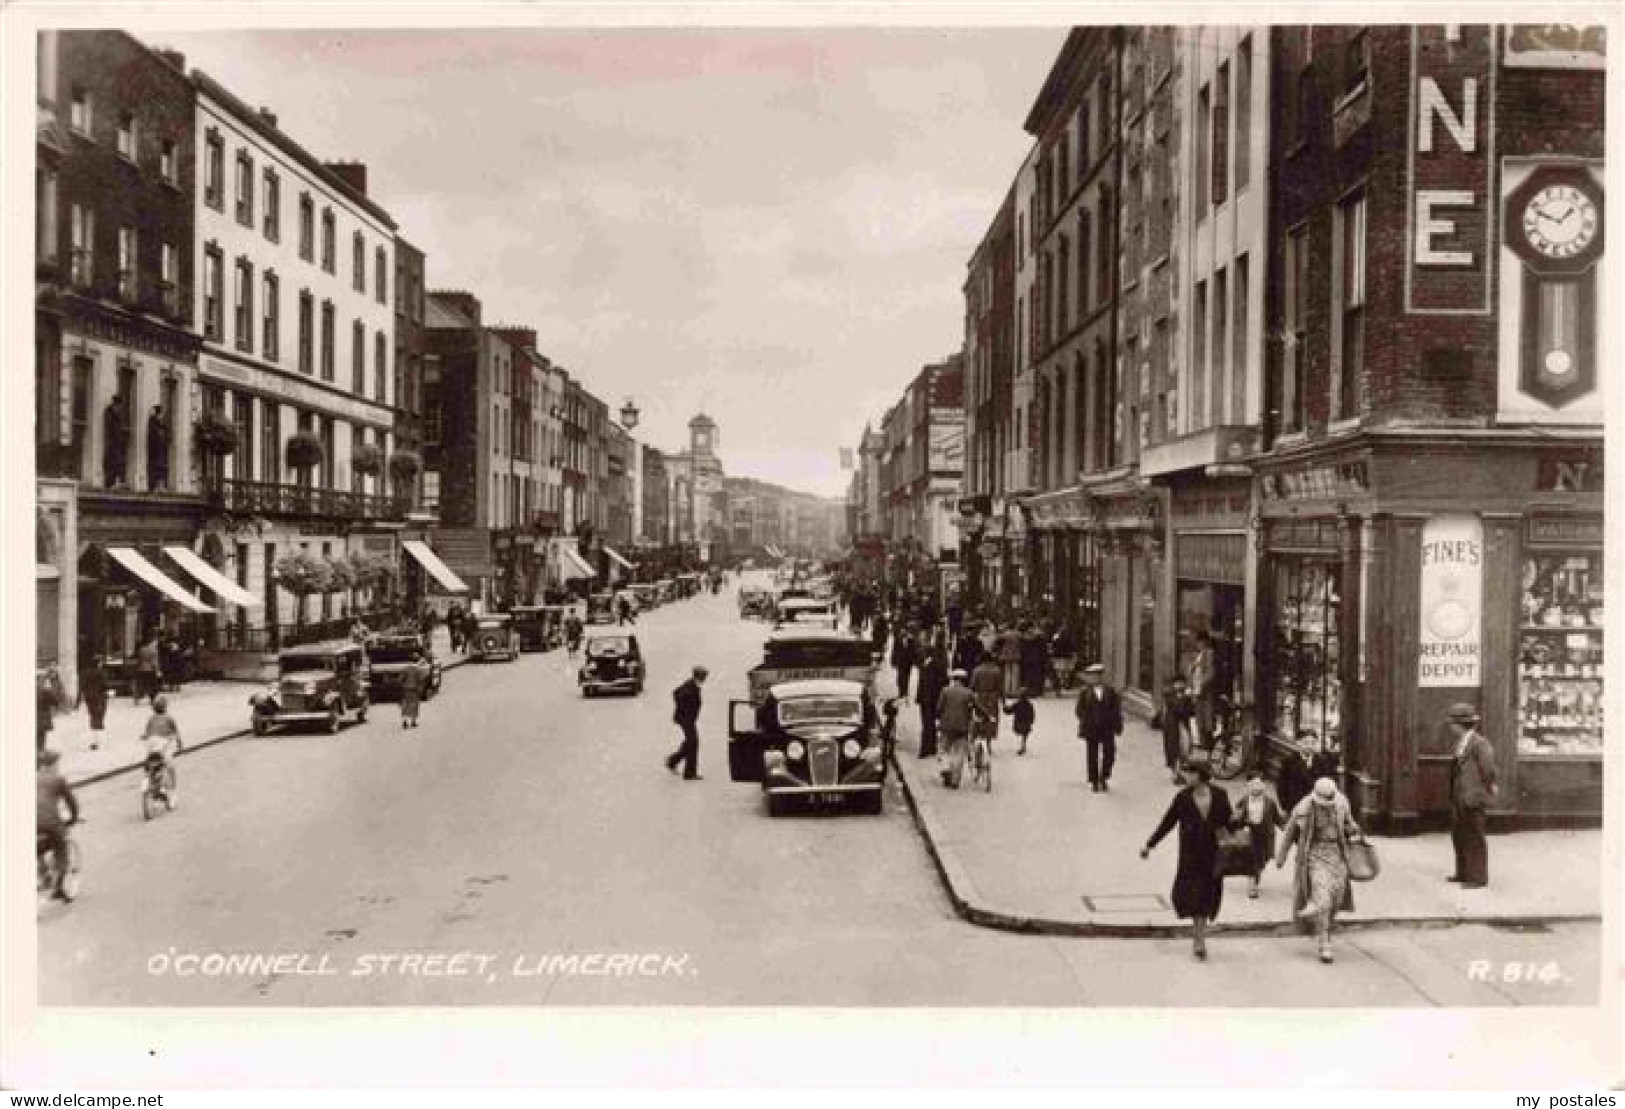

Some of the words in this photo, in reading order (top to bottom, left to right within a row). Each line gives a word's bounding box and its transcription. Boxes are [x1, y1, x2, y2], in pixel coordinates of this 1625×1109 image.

[1421, 541, 1480, 566] FINE'S
[1420, 643, 1478, 656] REPAIR
[1421, 664, 1475, 677] DEPOT
